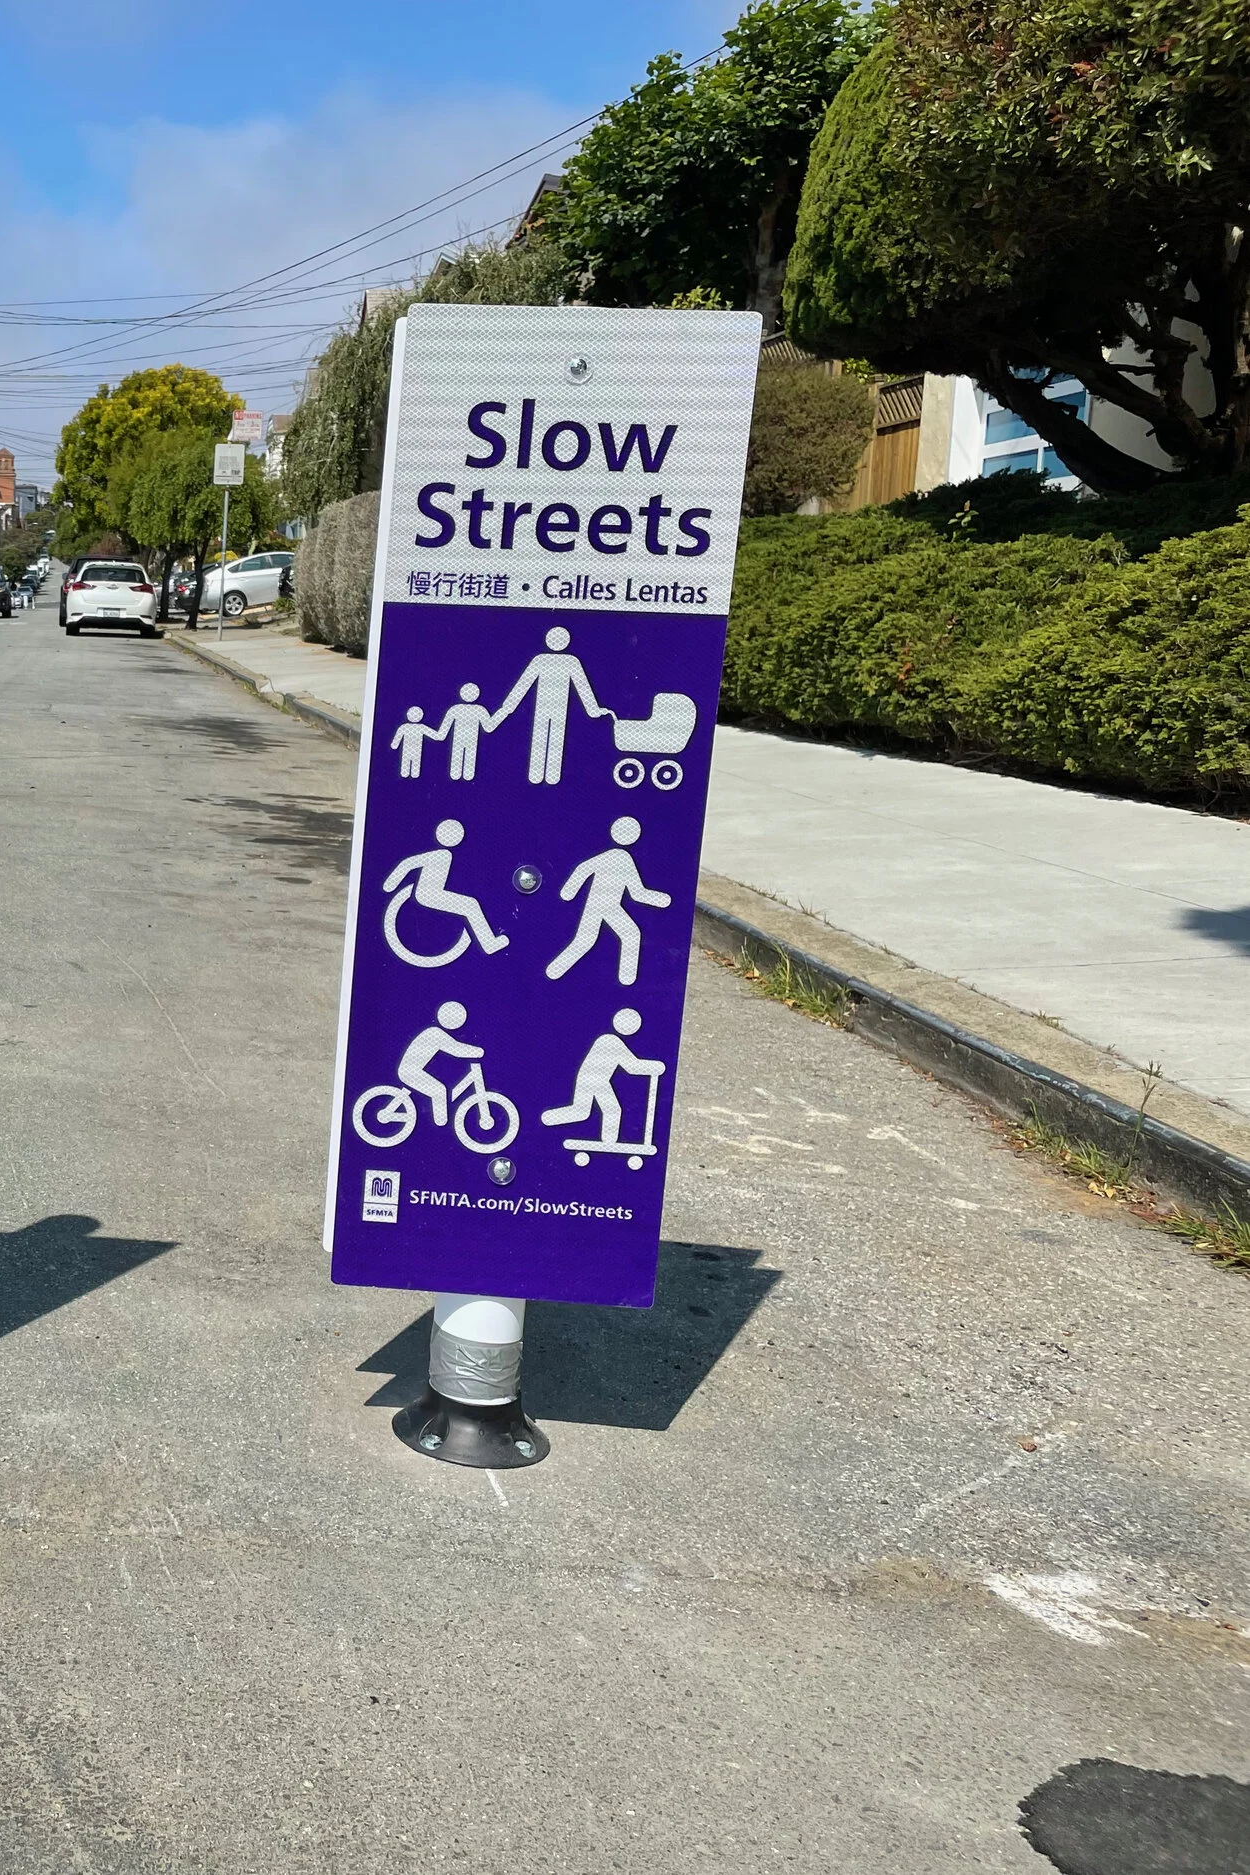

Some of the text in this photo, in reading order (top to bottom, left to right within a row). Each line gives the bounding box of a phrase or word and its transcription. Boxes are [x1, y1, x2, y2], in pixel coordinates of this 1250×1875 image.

[465, 398, 679, 473] Slow
[414, 482, 712, 557] Streets
[407, 570, 510, 599] 慢行街道
[542, 575, 708, 604] Calles Lentas
[366, 1209, 394, 1217] SFMTA
[409, 1189, 634, 1221] SFMTA.com/SlowStreets
